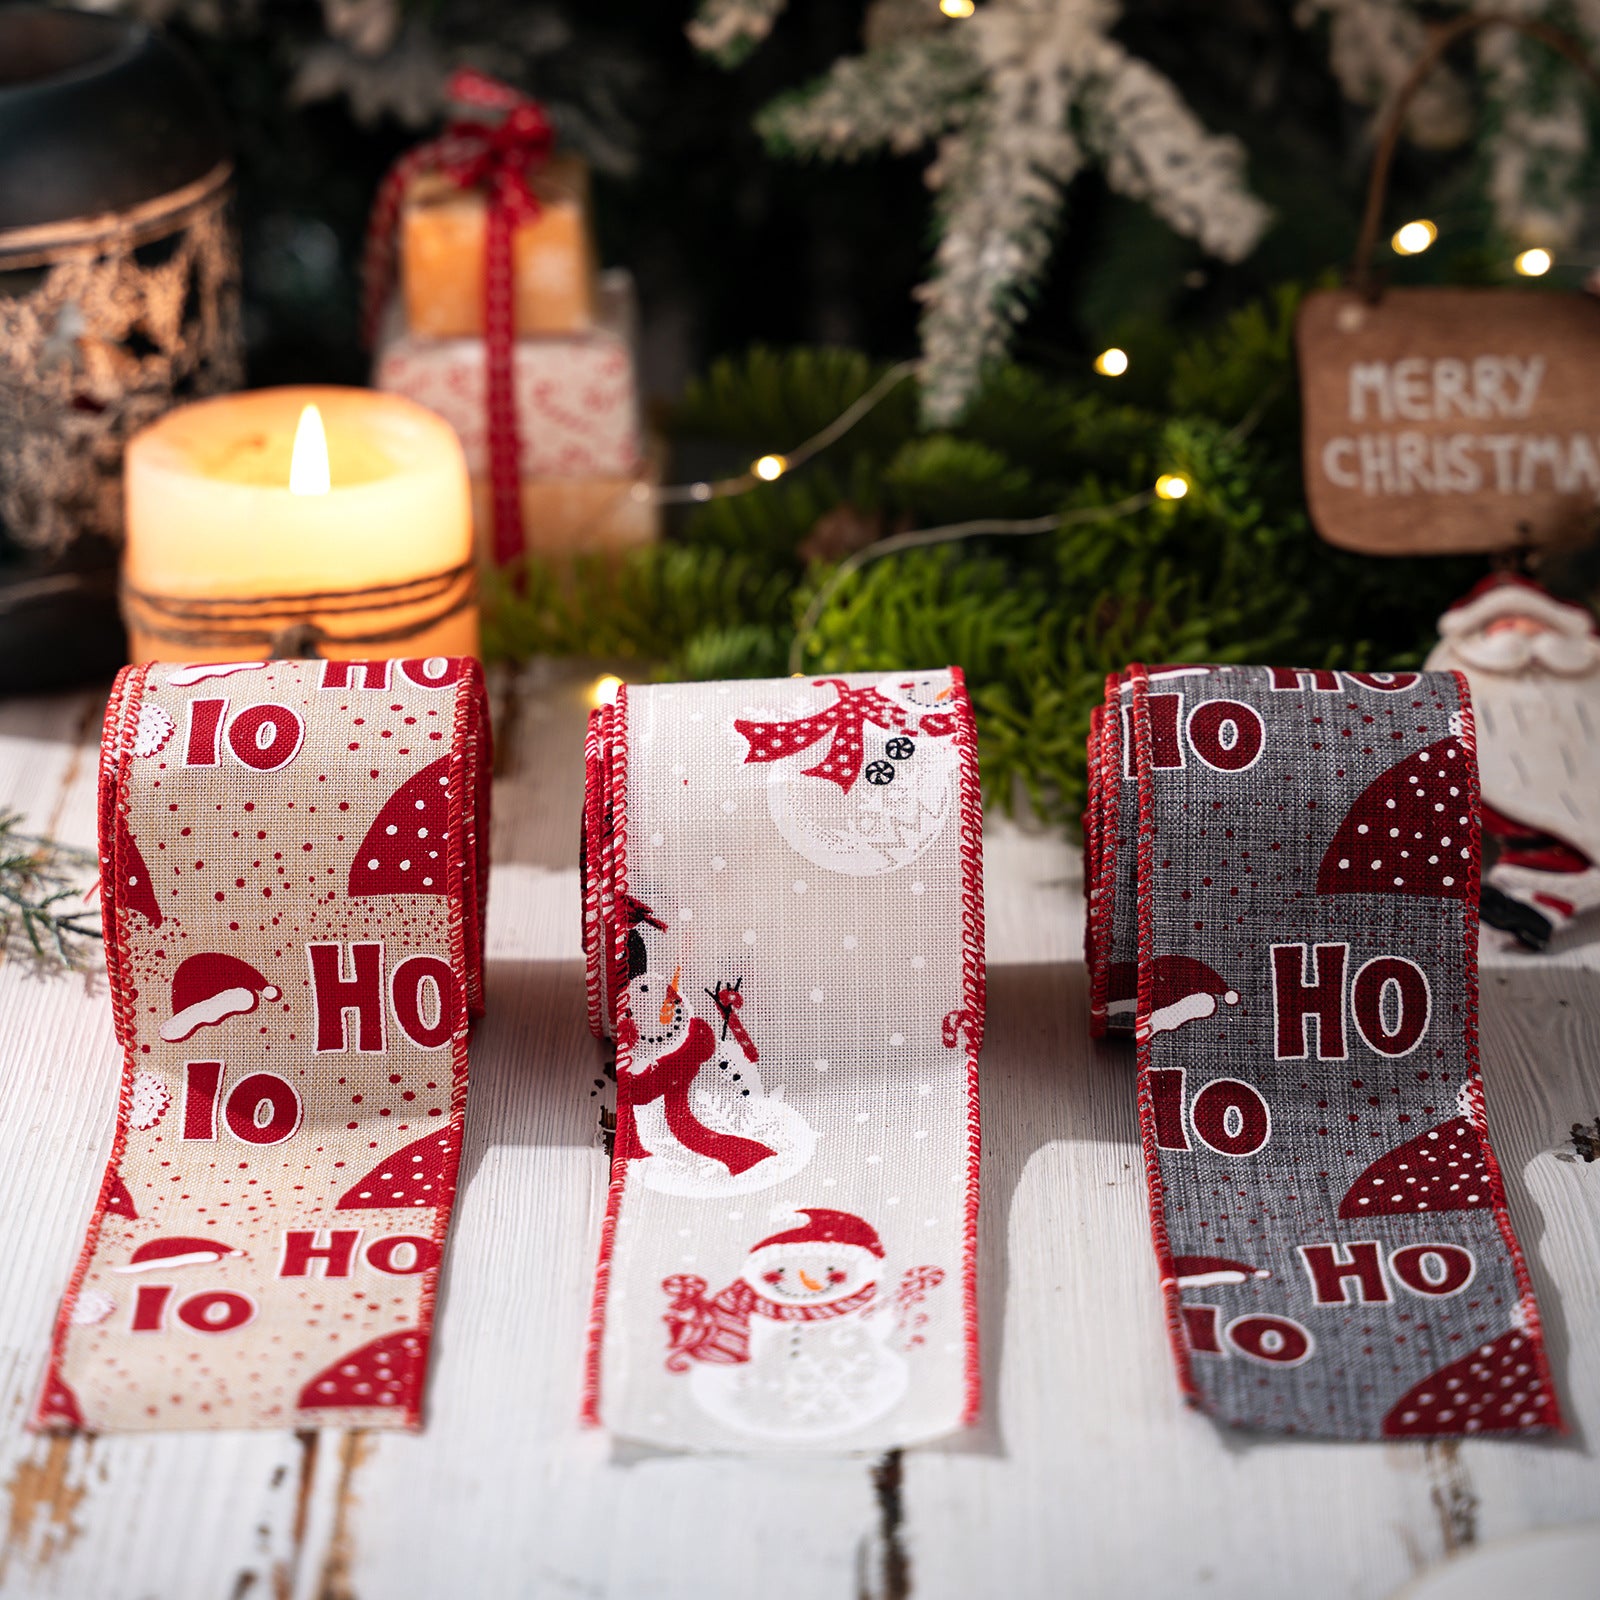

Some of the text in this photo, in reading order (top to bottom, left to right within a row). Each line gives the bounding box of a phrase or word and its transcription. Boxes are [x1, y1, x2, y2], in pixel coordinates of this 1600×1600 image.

[1350, 354, 1545, 422] MERRY
[1321, 432, 1600, 496] CHRISTMA
[305, 941, 454, 1055] HO
[1270, 942, 1432, 1060] HO
[277, 1228, 440, 1279] HO
[1298, 1240, 1477, 1307] HO
